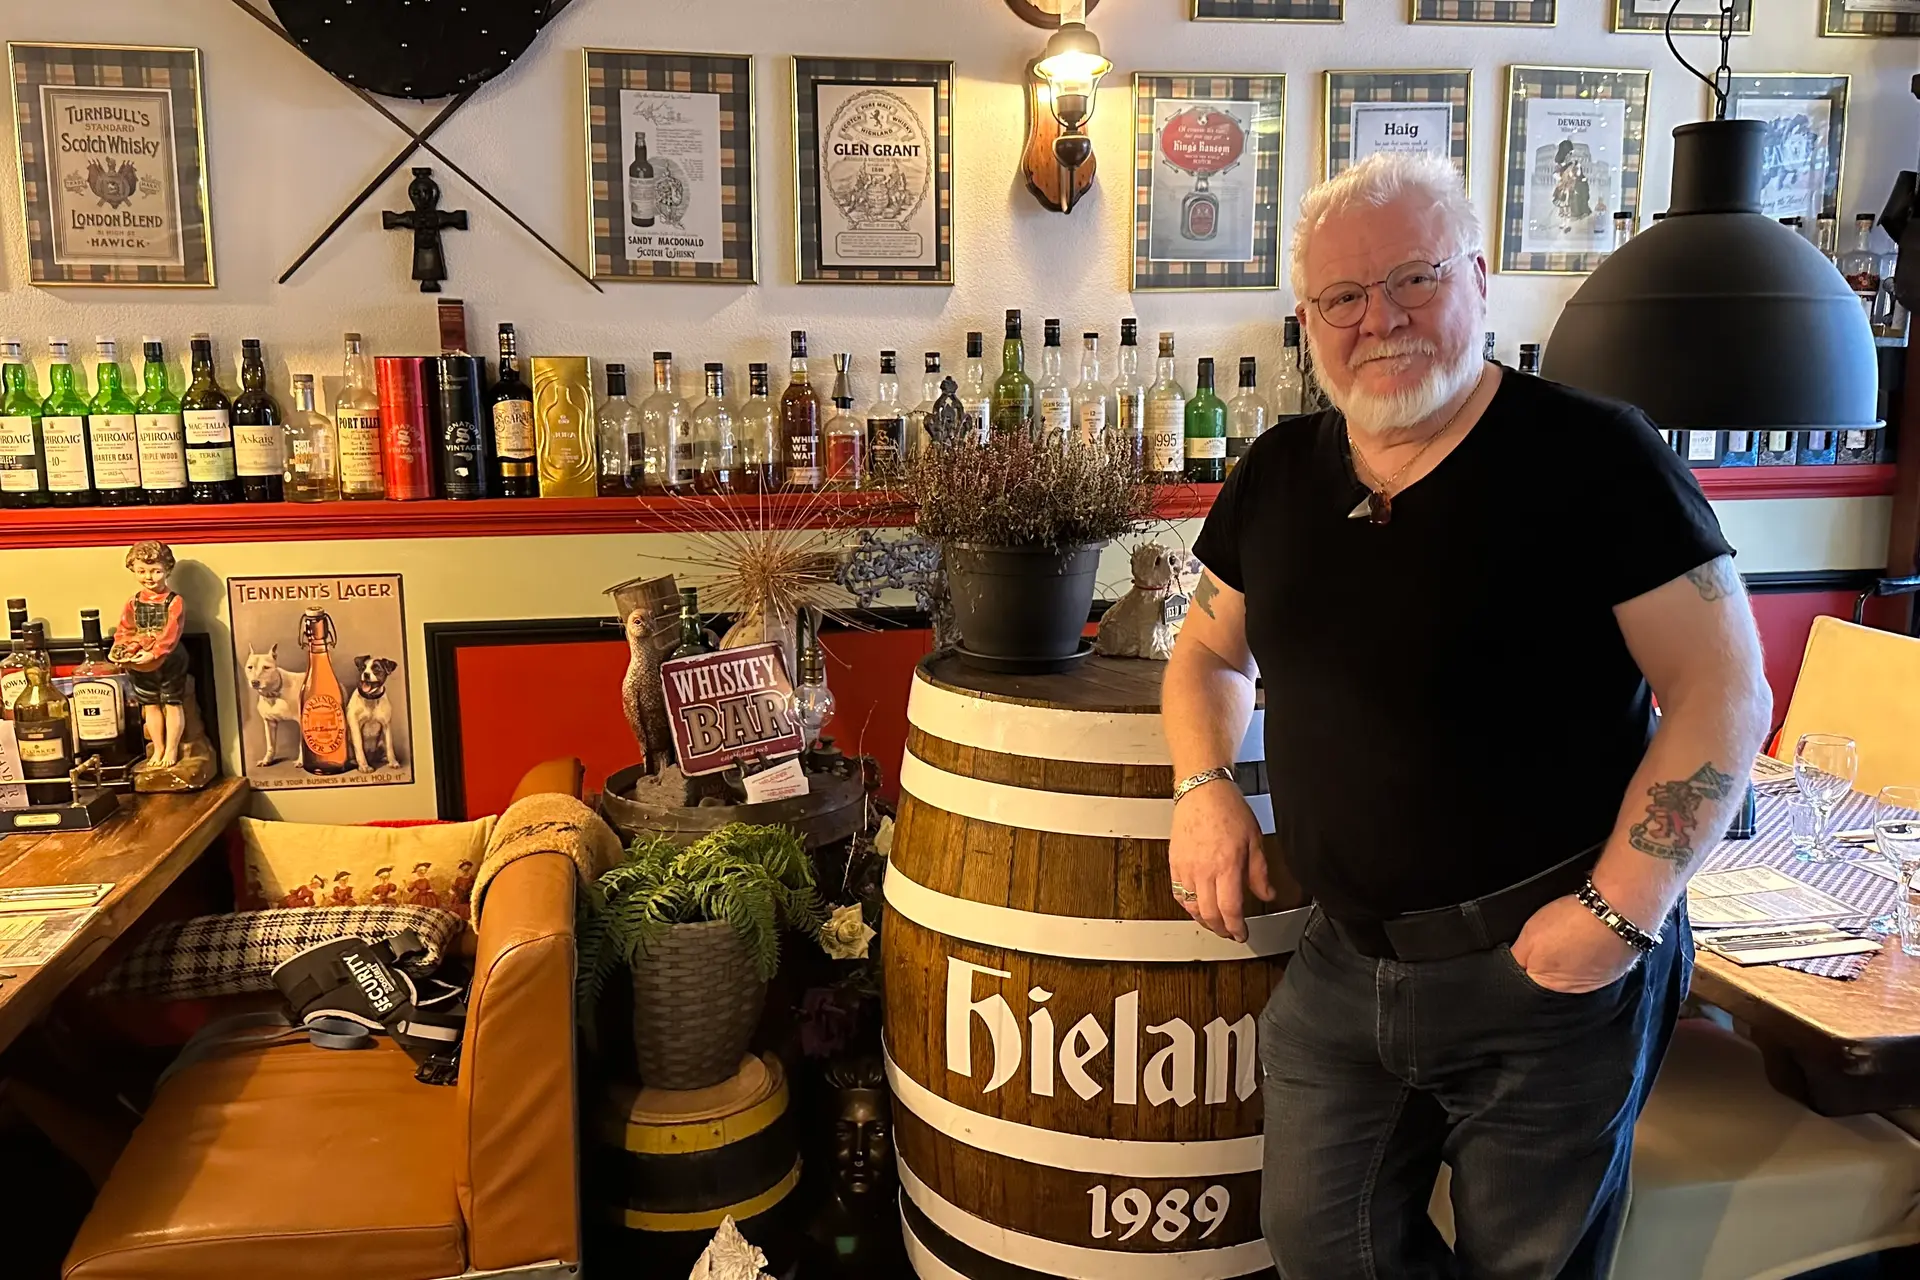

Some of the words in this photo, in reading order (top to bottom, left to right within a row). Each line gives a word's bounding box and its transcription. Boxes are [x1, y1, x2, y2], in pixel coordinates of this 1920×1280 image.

[65, 105, 151, 127] TURNBULL'S
[85, 123, 135, 132] STANDARD
[861, 127, 893, 136] HIGHLAND
[1384, 122, 1419, 138] Haig
[107, 134, 160, 158] Whisky
[834, 143, 869, 156] GLEN
[873, 144, 921, 157] GRANT
[1173, 140, 1196, 153] King's
[71, 209, 120, 229] LONDON
[122, 211, 163, 228] BLEND
[91, 238, 146, 248] HAWICK
[628, 236, 653, 245] SANDY
[658, 237, 704, 247] MACDONALD
[188, 422, 227, 430] MAC-TALLA
[339, 417, 359, 429] PORT
[361, 417, 380, 429] ELLE
[444, 421, 482, 440] SIGNATORY
[1155, 433, 1177, 447] 1995
[446, 444, 483, 452] VINTAGE
[235, 582, 331, 603] TENNENT'S
[337, 580, 392, 600] LAGER
[670, 654, 778, 704] WHISKEY
[86, 708, 97, 716] 12
[680, 690, 796, 759] BAR
[306, 776, 338, 785] BUSINESS
[371, 773, 392, 782] HOLD
[342, 953, 393, 1011] SECURITY
[946, 955, 1257, 1108] Hielan
[1087, 1185, 1231, 1242] 1989
